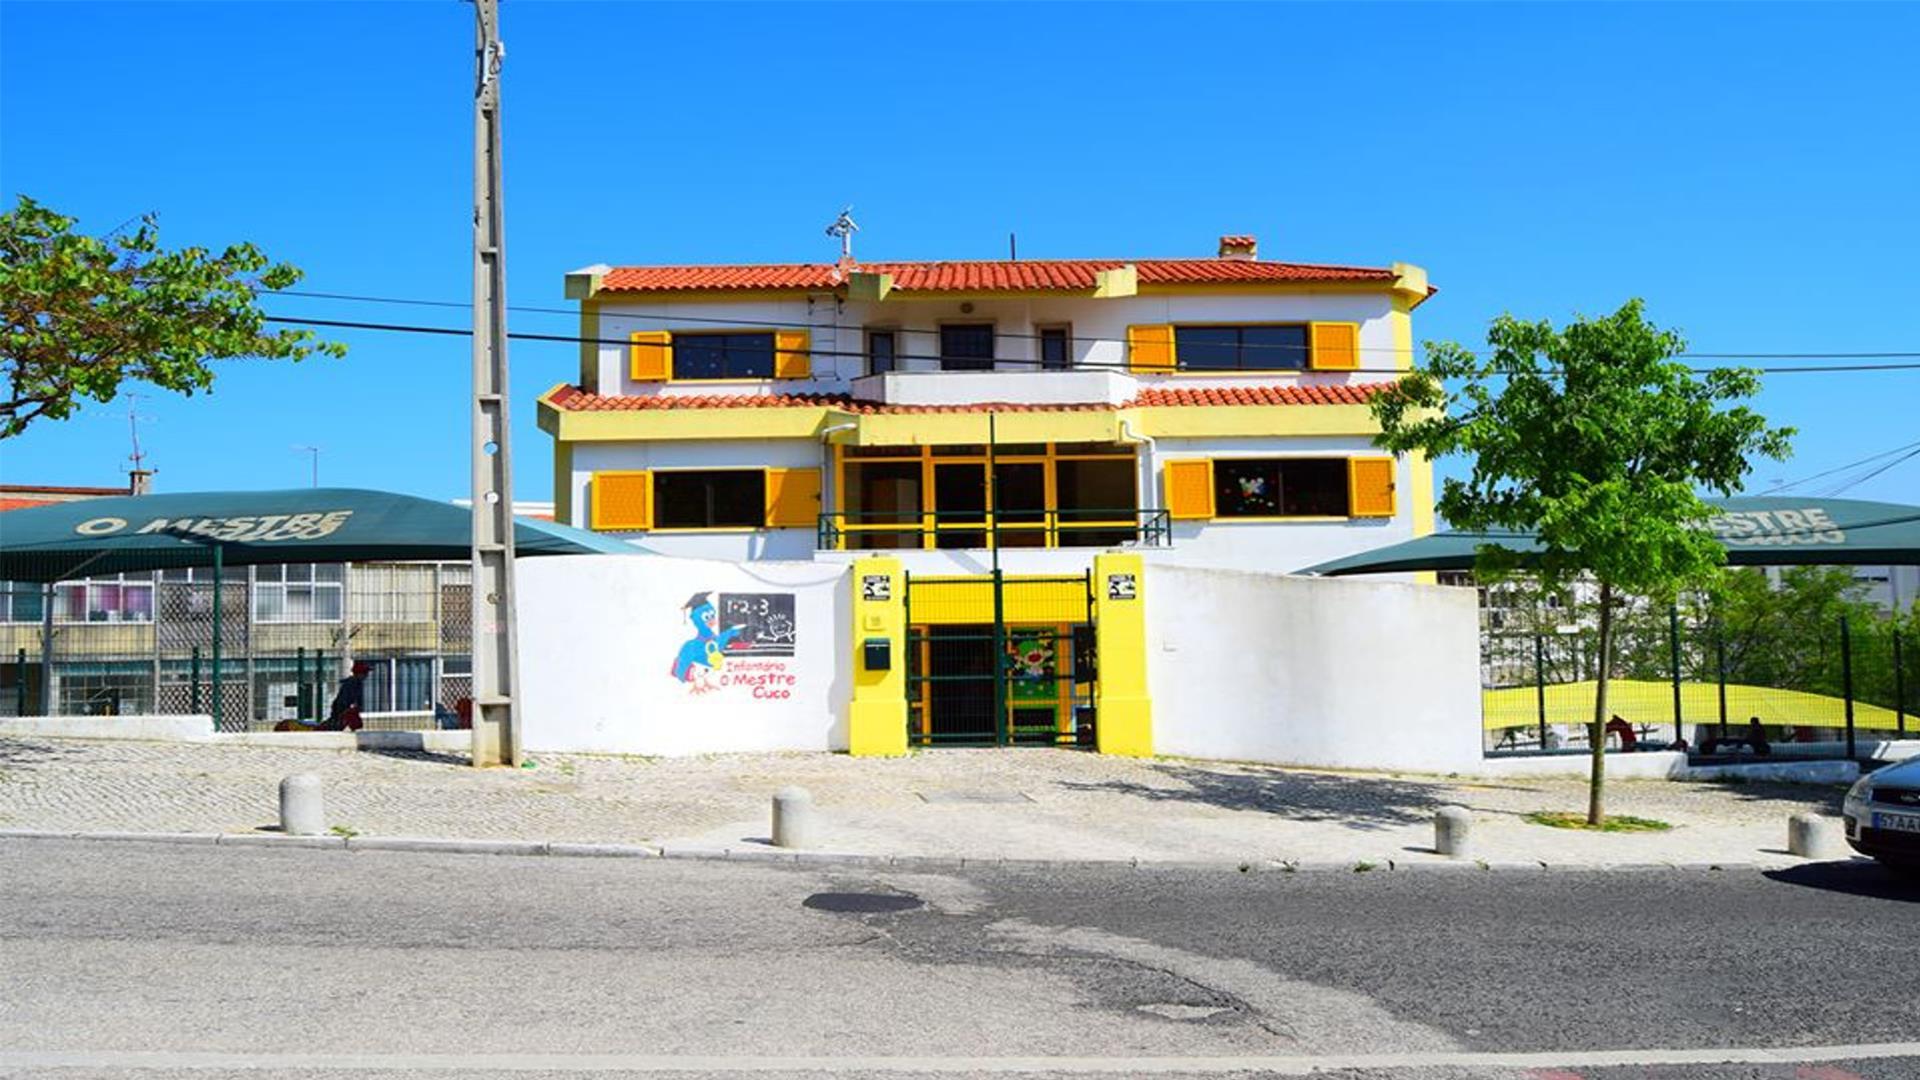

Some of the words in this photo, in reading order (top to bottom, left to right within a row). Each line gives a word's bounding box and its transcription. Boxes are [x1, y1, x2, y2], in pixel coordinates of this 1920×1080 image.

[75, 517, 128, 535] O
[733, 673, 796, 686] Mestre
[753, 685, 791, 699] Cuco
